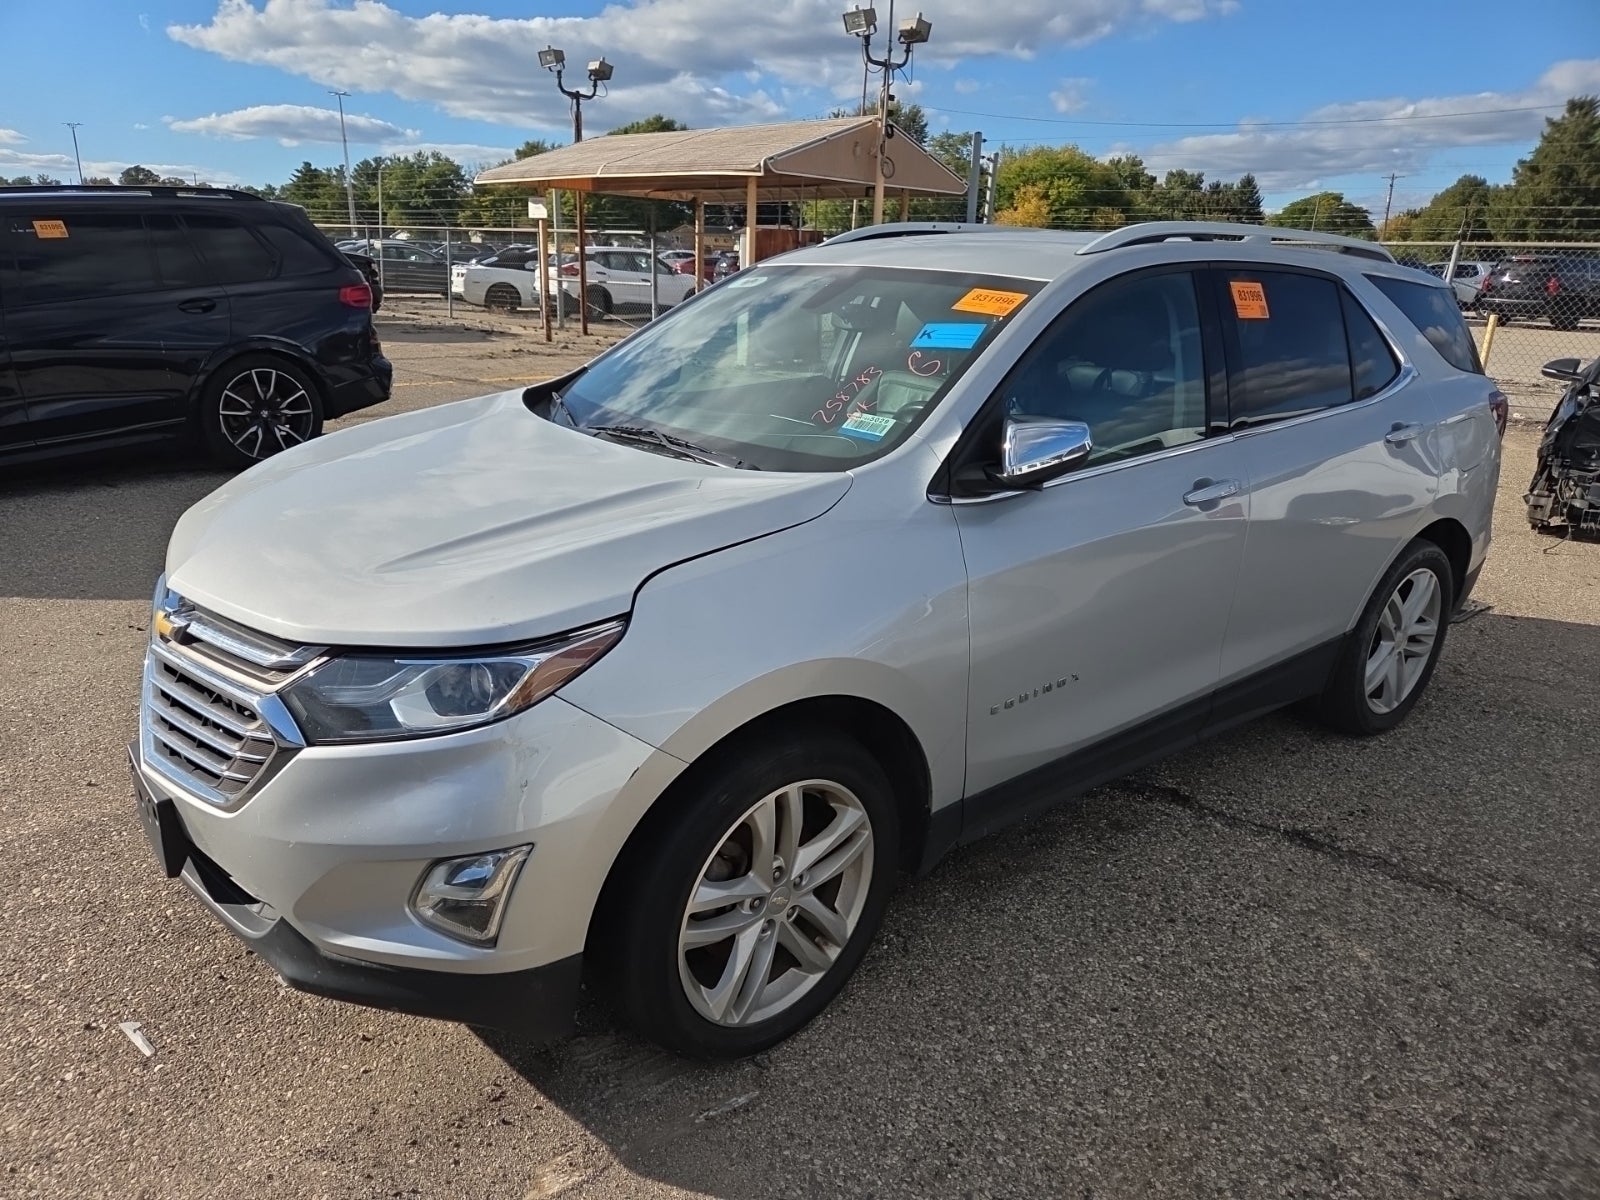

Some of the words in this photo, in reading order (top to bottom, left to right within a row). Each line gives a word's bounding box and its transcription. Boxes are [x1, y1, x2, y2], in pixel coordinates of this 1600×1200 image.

[972, 294, 1018, 305] 831996
[1237, 290, 1263, 301] 831996
[919, 329, 938, 339] K
[811, 366, 883, 423] 258783
[990, 672, 1079, 715] EQUINOX
